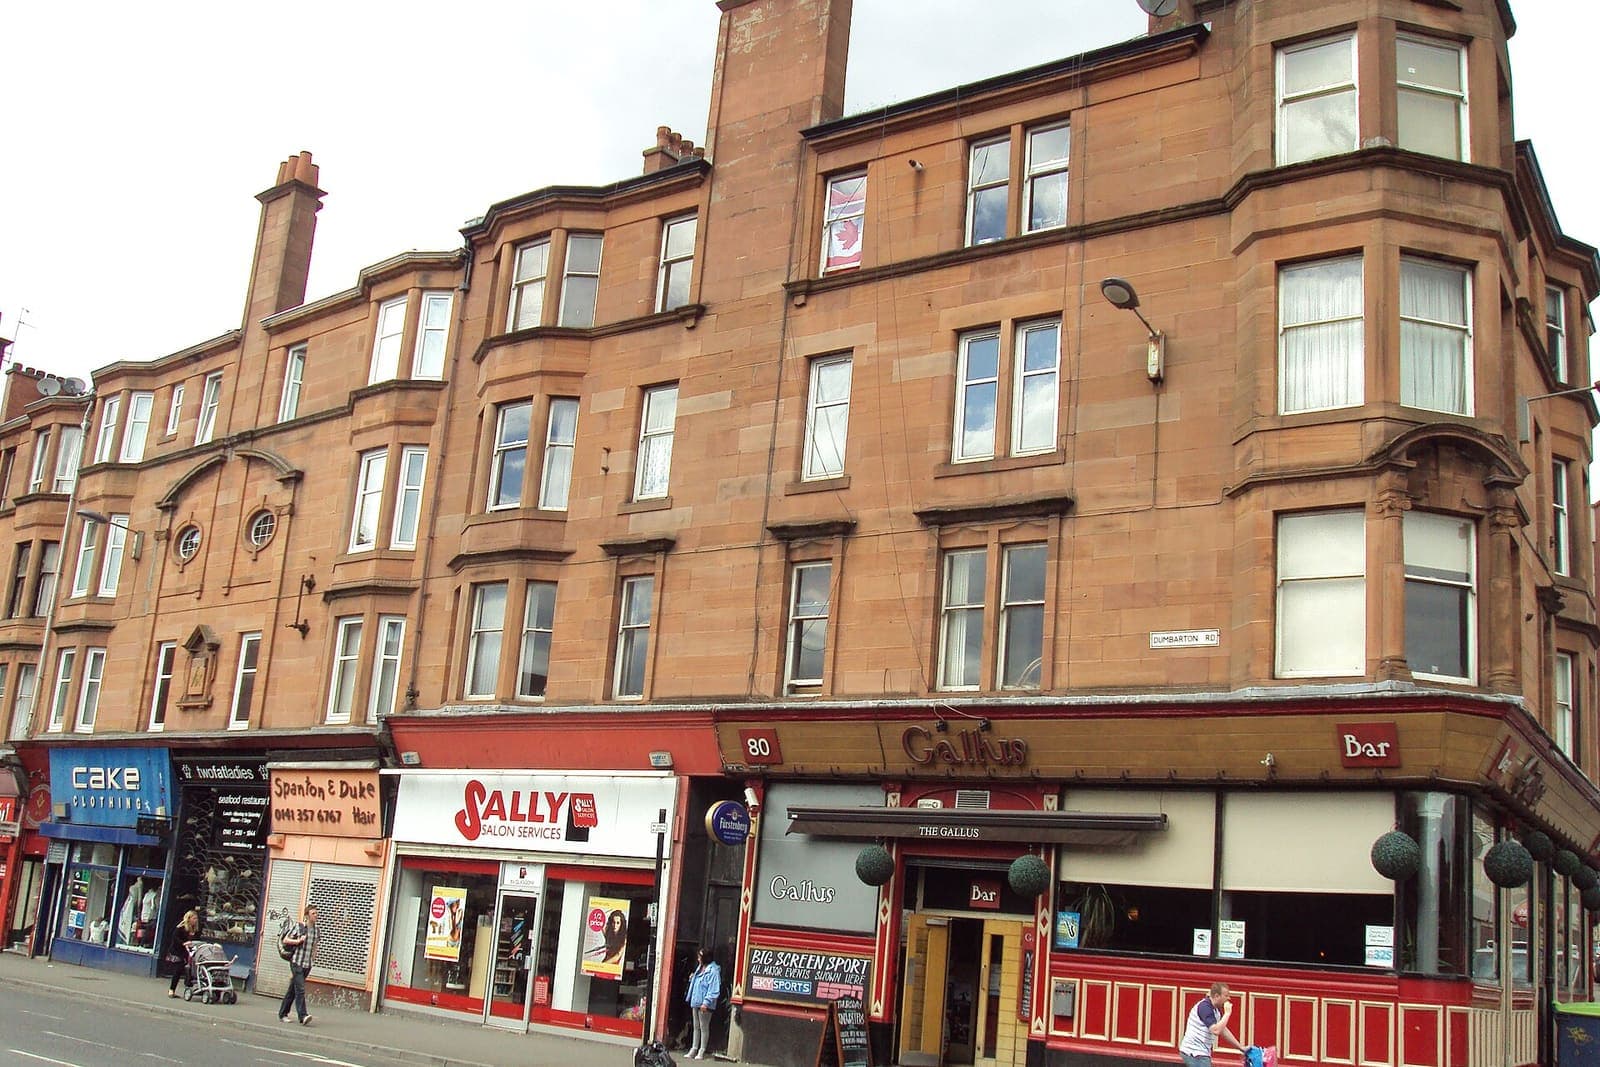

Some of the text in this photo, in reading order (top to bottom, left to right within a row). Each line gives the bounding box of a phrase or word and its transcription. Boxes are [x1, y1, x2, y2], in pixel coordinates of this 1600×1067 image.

[1153, 634, 1216, 644] DUMBARTON RD
[747, 737, 770, 756] 80
[902, 725, 1027, 765] Gallus
[1343, 734, 1391, 757] Bar
[196, 764, 255, 780] twofatladies
[275, 776, 326, 801] Spanton
[339, 780, 376, 800] Duke
[73, 796, 142, 810] CLOTHING
[218, 795, 241, 805] seafood
[575, 799, 593, 812] SALLY
[274, 808, 294, 822] 0141
[297, 809, 314, 822] 357
[317, 809, 342, 824] 6767
[352, 806, 376, 824] Hair
[455, 780, 569, 841] SALLY
[482, 825, 561, 840] SALON SERVICES
[720, 817, 748, 834] Fürstenberg
[919, 827, 980, 838] THE GALLUS
[770, 875, 836, 903] Gallus
[971, 885, 997, 902] Bar
[751, 950, 872, 975] BIG SCREEN SPORT
[751, 965, 866, 985] ALL MAJOR EVENTS SHOWN HERE
[752, 977, 811, 993] SKY SPORTS
[816, 981, 864, 1000] ESPN
